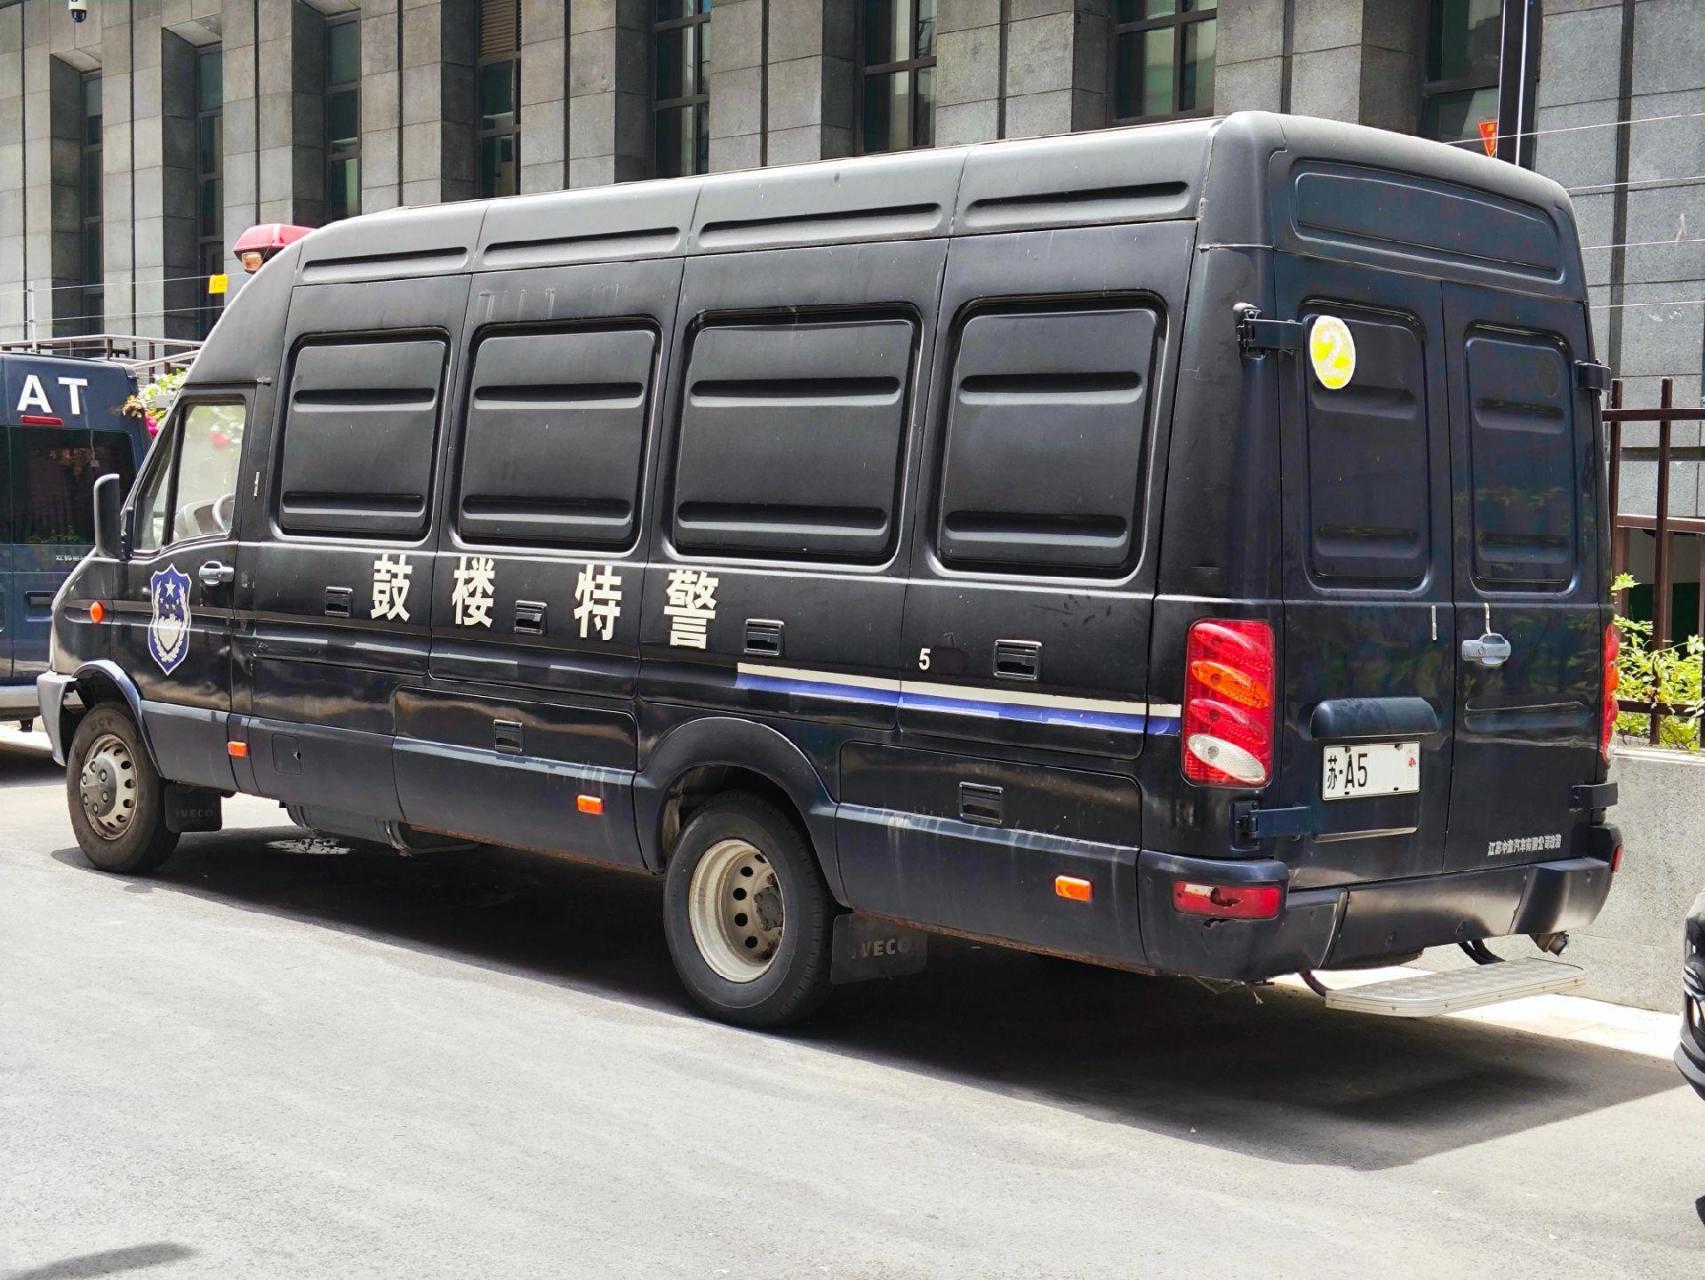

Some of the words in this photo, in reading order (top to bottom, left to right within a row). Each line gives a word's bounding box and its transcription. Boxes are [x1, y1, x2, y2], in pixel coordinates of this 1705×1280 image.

[16, 374, 88, 415] AT
[369, 553, 720, 650] 鼓楼特警
[918, 647, 931, 671] 5
